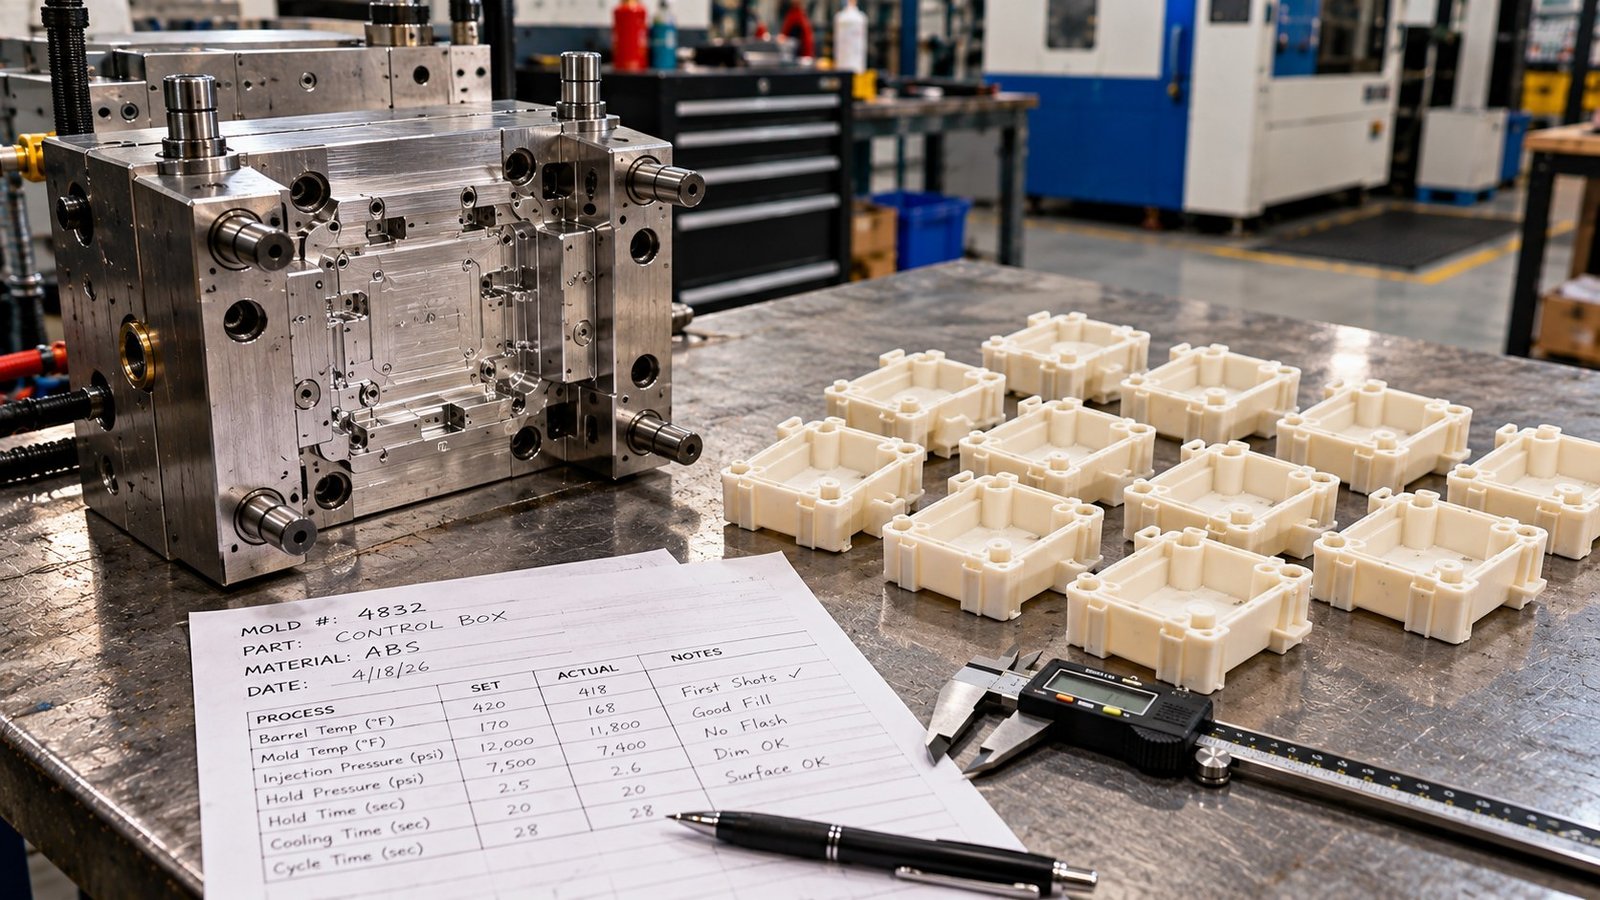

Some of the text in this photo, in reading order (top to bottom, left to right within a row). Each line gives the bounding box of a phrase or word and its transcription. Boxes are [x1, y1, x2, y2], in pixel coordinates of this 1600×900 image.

[241, 602, 426, 637] MOLD #: 4832
[243, 610, 508, 656] PART: CONTROL BOX
[245, 641, 420, 676] MATERIAL: ABS
[671, 648, 722, 662] NOTES
[247, 661, 429, 697] DATE: 4/18/26
[558, 665, 619, 680] ACTUAL
[471, 681, 501, 692] SET
[579, 685, 607, 697] 418
[681, 674, 777, 697] First Shots
[257, 706, 335, 724] PROCESS
[473, 701, 505, 713] 420
[588, 703, 616, 716] 168
[692, 694, 771, 719] Good Fill
[259, 729, 307, 744] Barrel
[316, 723, 357, 736] Temp
[481, 720, 509, 732] 170
[591, 720, 640, 736] 11,800
[705, 714, 788, 738] No Flash
[481, 737, 534, 752] 12,000
[597, 740, 646, 756] 7,400
[714, 737, 789, 761] Dim OK
[261, 750, 299, 763] Mold
[308, 745, 348, 757] Temp
[264, 749, 444, 785] Injection Pressure (psi)
[486, 758, 536, 773] 7,500
[611, 762, 641, 776] 2.6
[725, 756, 830, 783] Surface OK
[266, 773, 424, 805] Hold Pressure (psi)
[499, 779, 530, 794] 2.5
[622, 785, 646, 797] 20
[269, 798, 405, 828] Hold Time (sec)
[507, 803, 531, 815] 20
[630, 805, 654, 819] 28
[270, 817, 430, 850] Cooling Time (sec)
[514, 824, 538, 838] 28
[273, 842, 424, 877] Cycle Time (sec)
